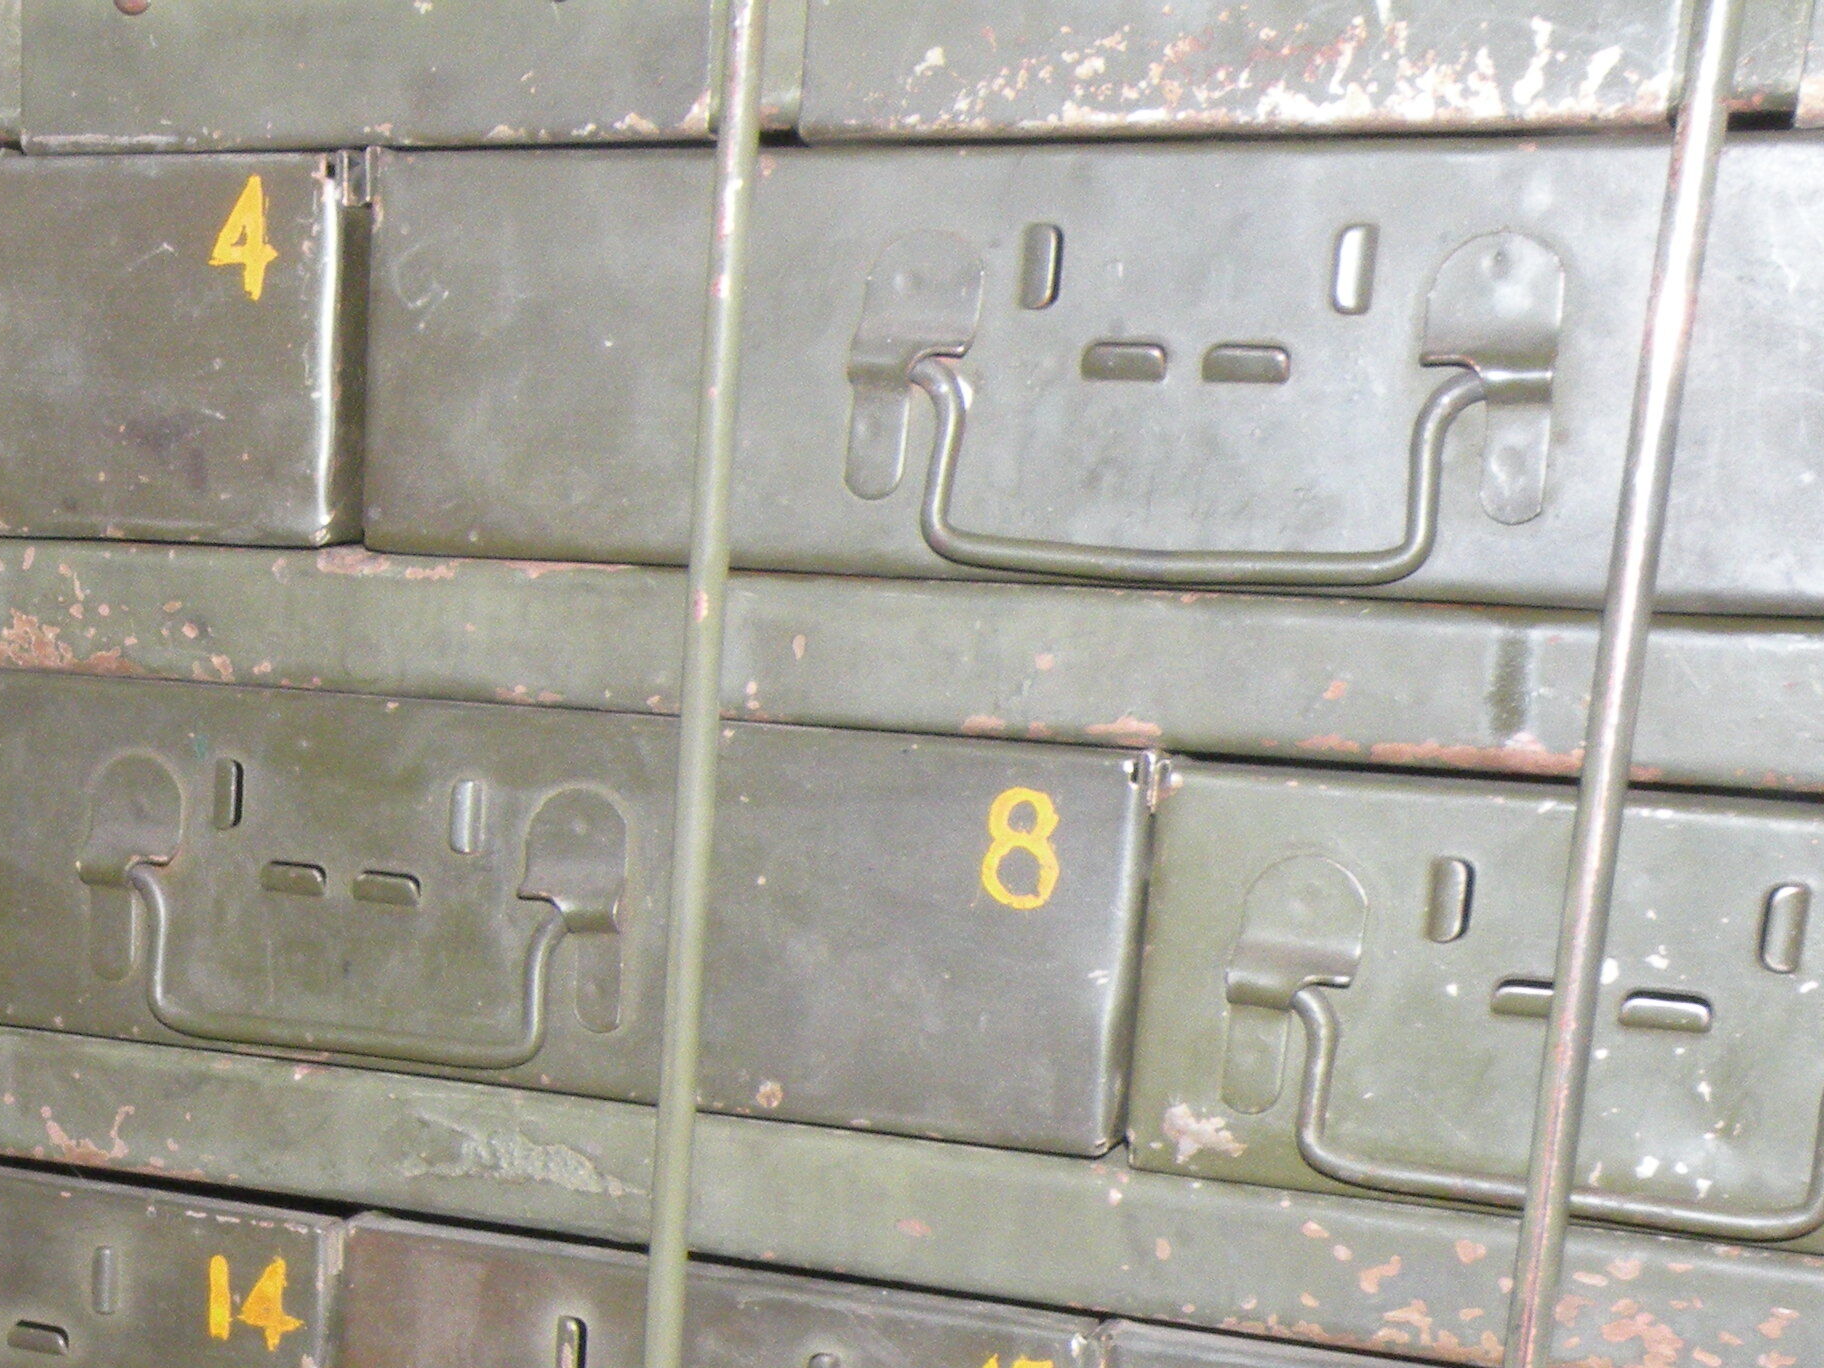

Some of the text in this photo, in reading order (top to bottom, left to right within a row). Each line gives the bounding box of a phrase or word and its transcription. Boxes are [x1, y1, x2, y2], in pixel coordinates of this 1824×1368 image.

[206, 174, 278, 302] 4
[983, 784, 1062, 913] 8
[203, 1252, 304, 1355] 14
